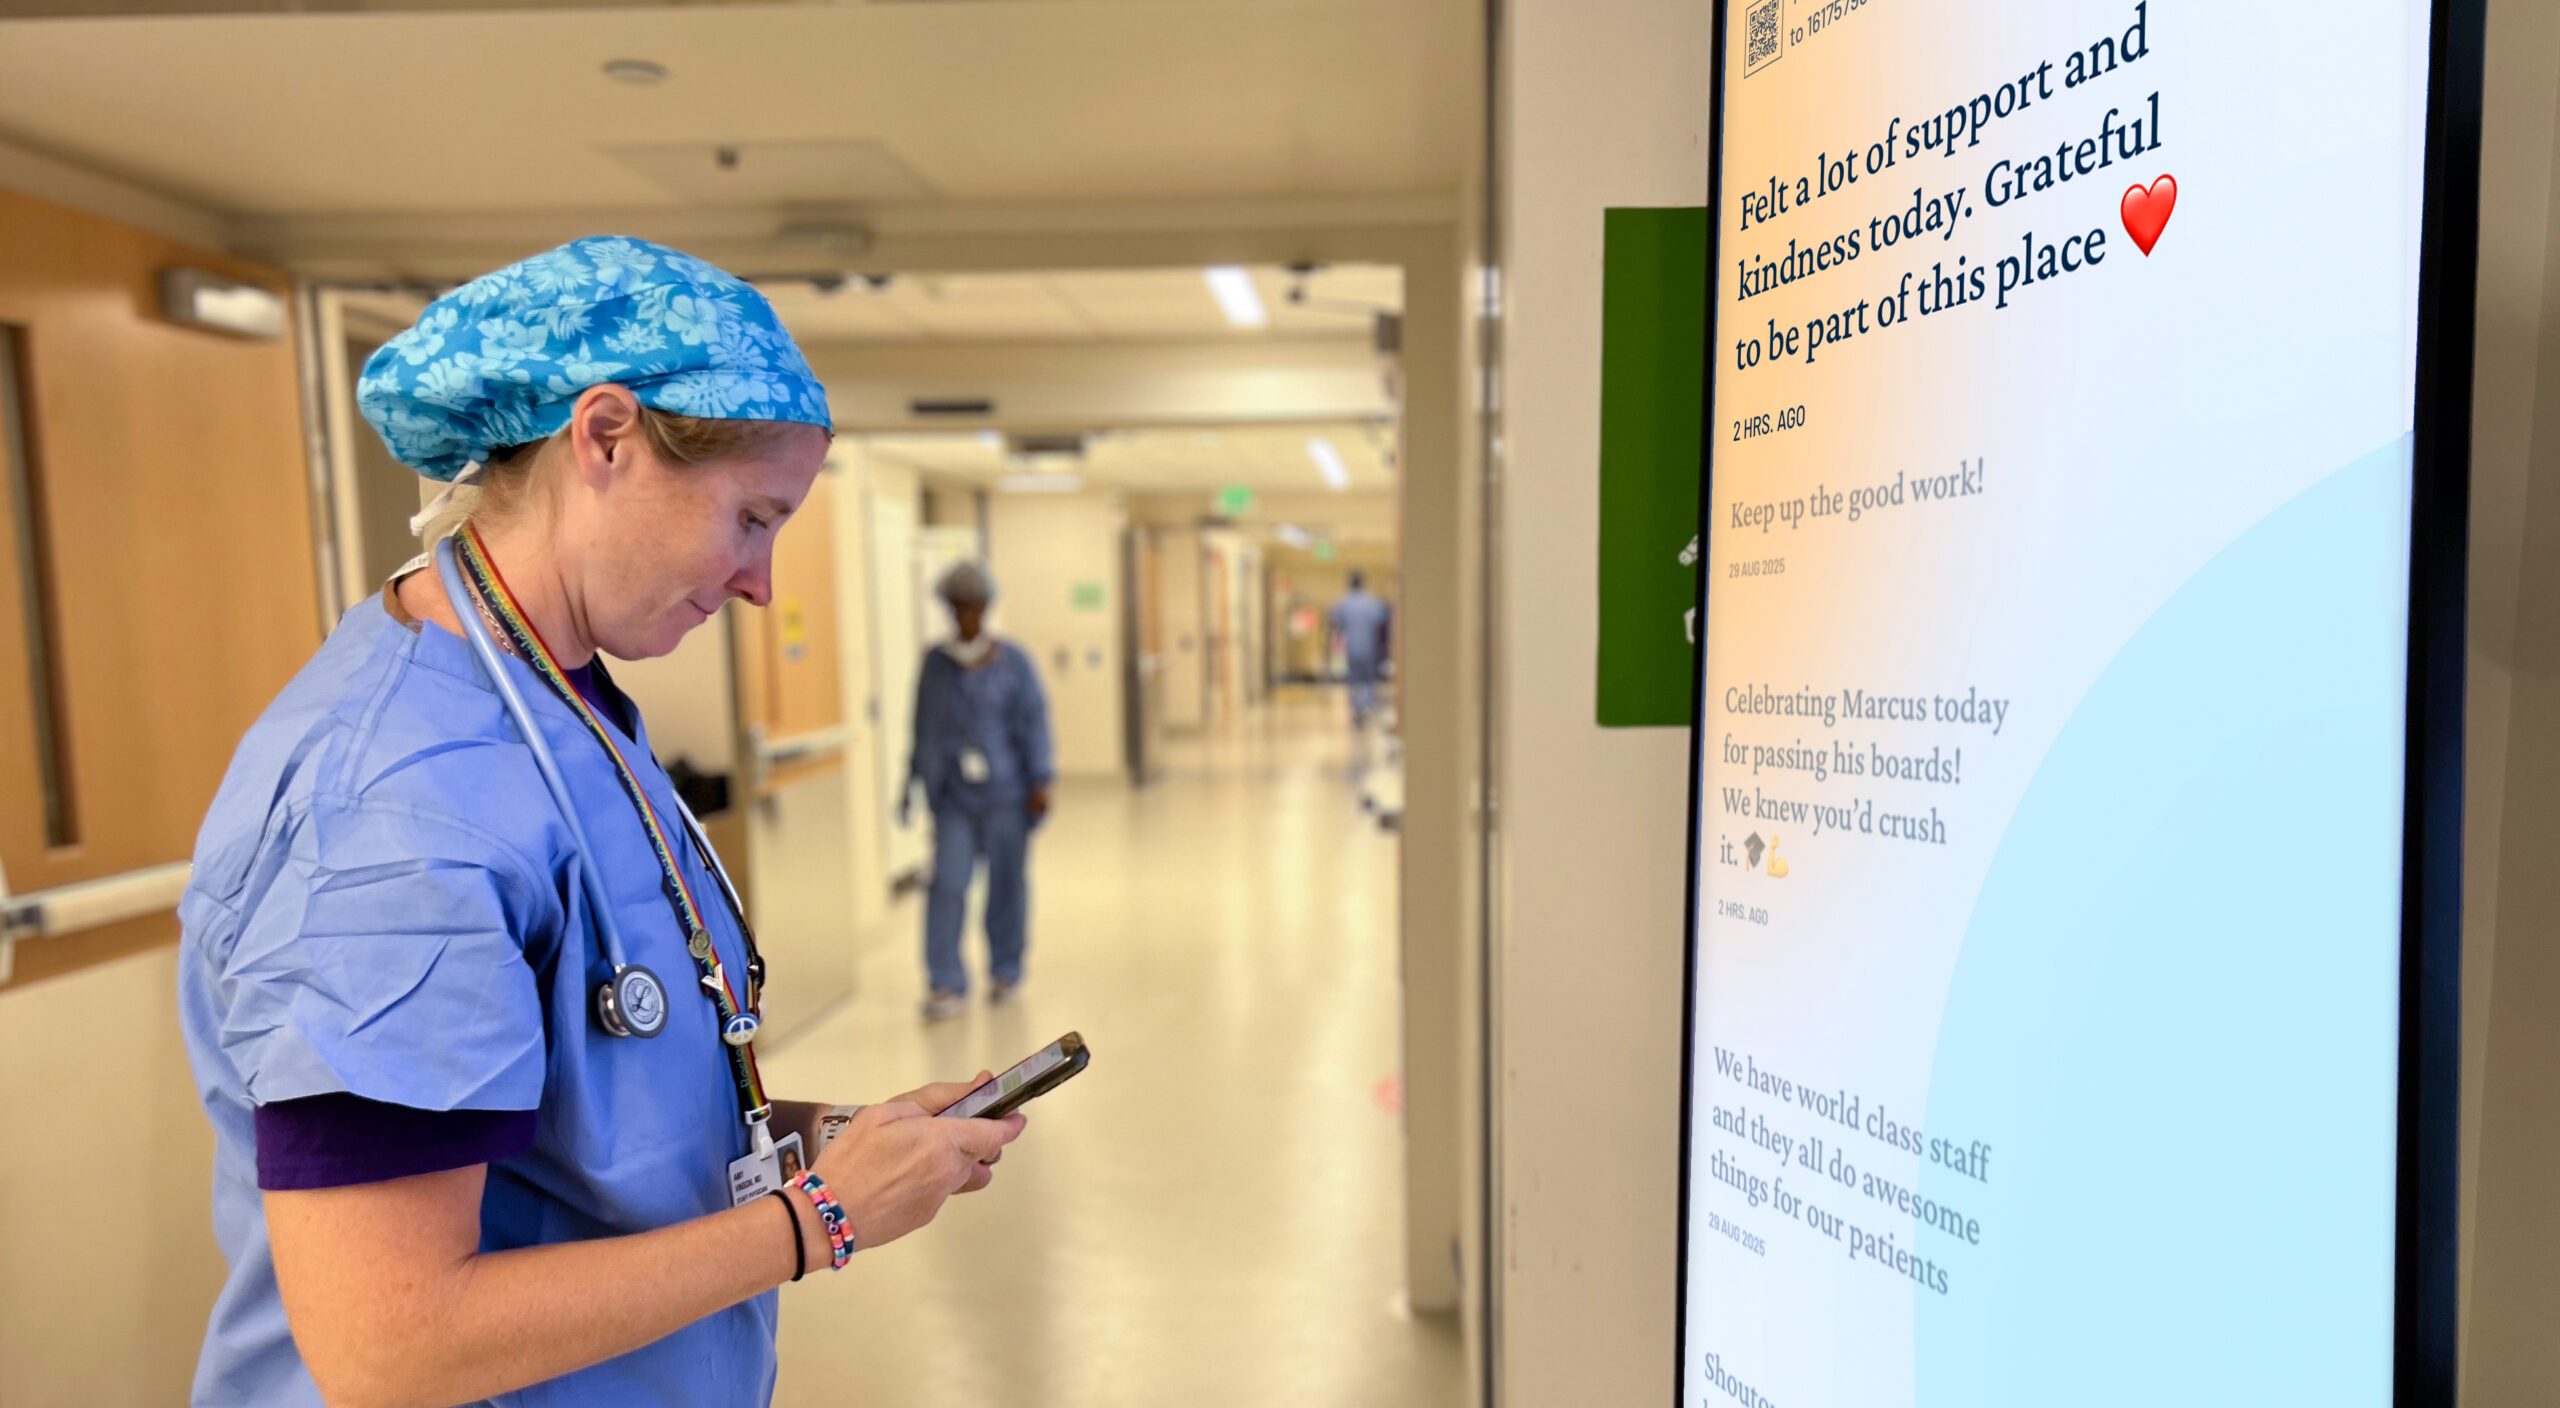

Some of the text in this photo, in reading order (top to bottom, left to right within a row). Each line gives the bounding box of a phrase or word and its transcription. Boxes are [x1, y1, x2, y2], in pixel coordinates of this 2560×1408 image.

[1790, 0, 1867, 46] to 1617579
[1740, 0, 2150, 230] Felt a lot of support and
[1738, 91, 2162, 301] kindness today. Grateful
[1736, 227, 2107, 370] to be part of this place
[1733, 405, 1806, 441] 2 HRS. AGO
[1731, 457, 1984, 533] Keep up the good work!
[1729, 558, 1785, 579] 29 AUG 2025
[1725, 683, 2010, 736] Celebrating Marcus today
[1723, 733, 1961, 785] for passing his boards!
[1722, 786, 1751, 817] We
[1755, 787, 1808, 824] knew
[1879, 807, 1947, 845] crush
[1720, 834, 1738, 866] it.
[1718, 900, 1769, 926] 2 HRS. AGO
[736, 1046, 753, 1088] Bosto
[1714, 1046, 1992, 1184] We have world class staff
[1713, 1104, 1980, 1246] and they all do awesome
[1708, 1212, 1765, 1257] 29 AUG 2025
[1711, 1149, 1948, 1296] things for our patients
[1705, 1352, 1775, 1408] Shouto
